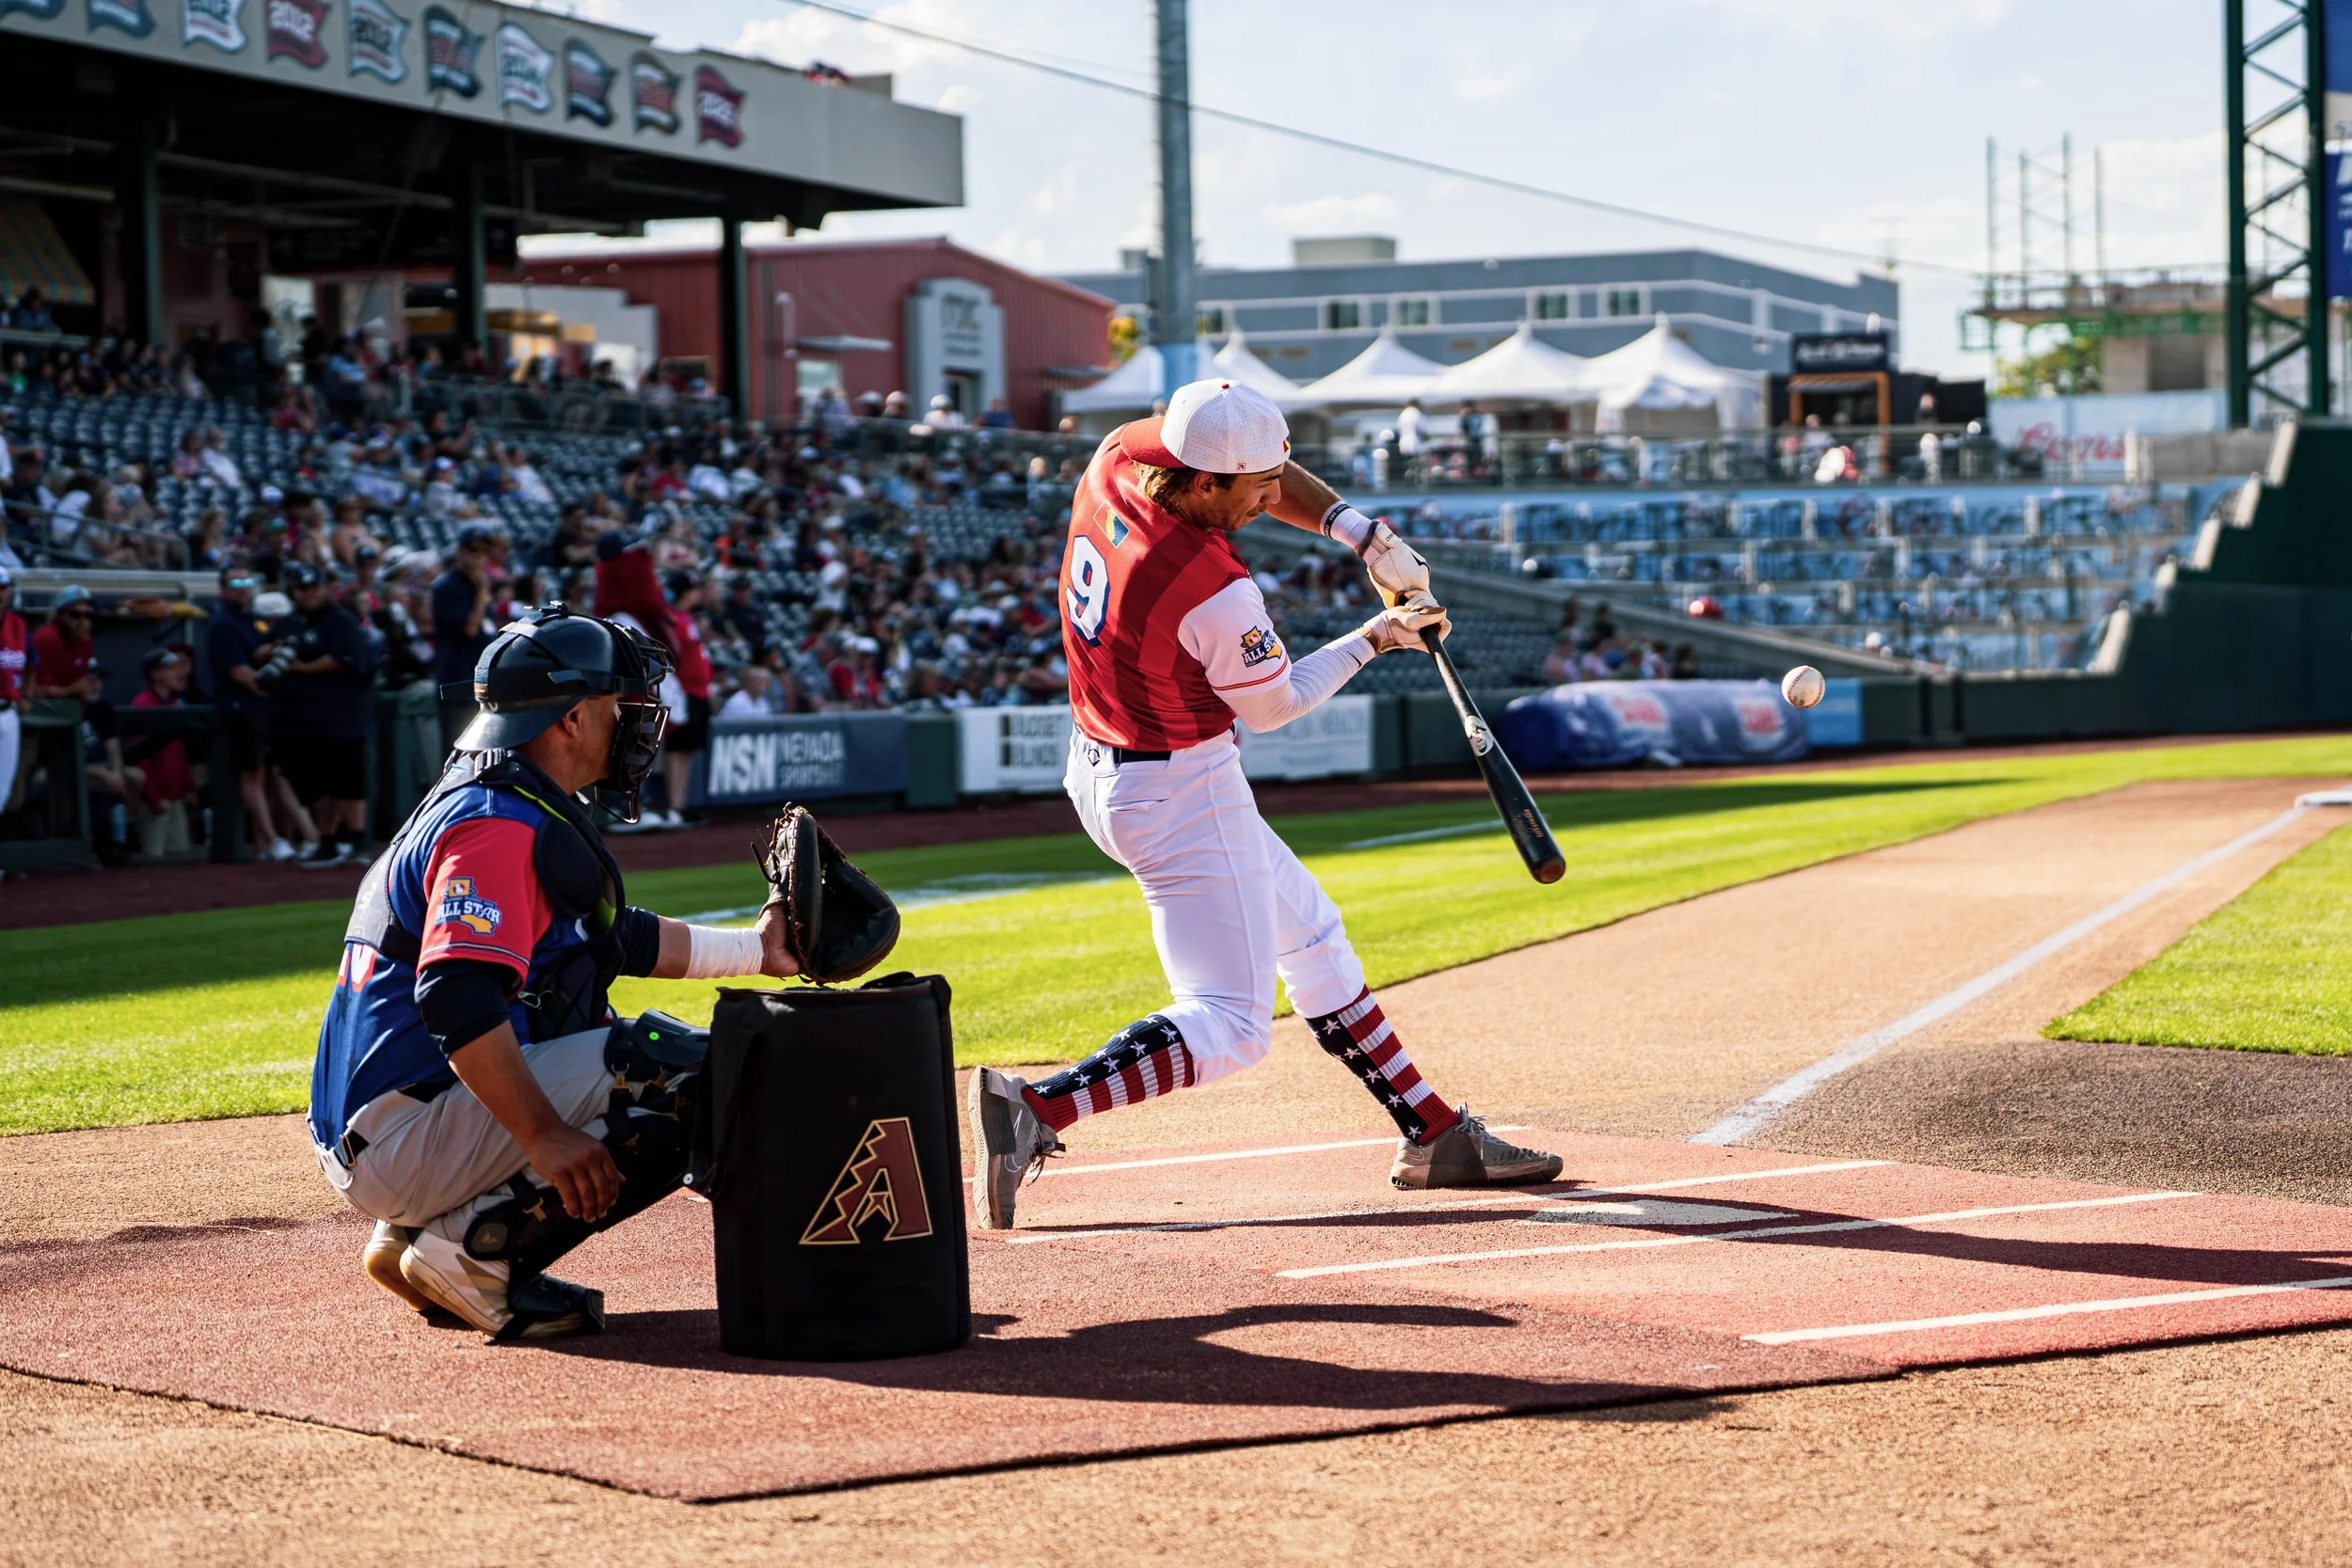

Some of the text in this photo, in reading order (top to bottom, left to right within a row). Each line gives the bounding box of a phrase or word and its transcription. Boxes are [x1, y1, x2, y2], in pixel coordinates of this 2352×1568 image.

[1065, 534, 1110, 647] 9
[1243, 648, 1264, 664] ALL
[436, 900, 501, 925] ALL STAR
